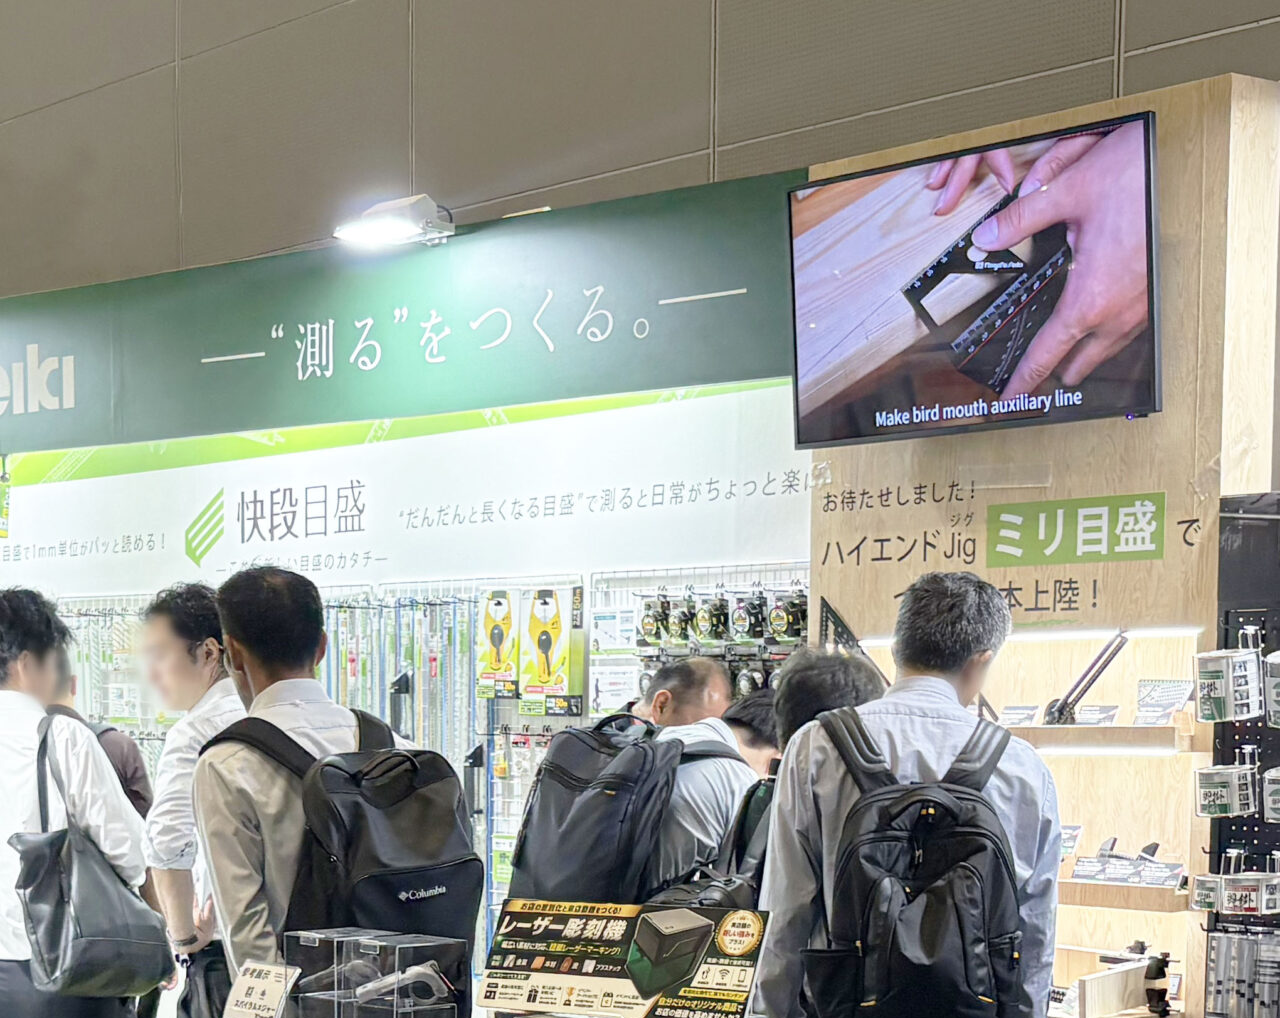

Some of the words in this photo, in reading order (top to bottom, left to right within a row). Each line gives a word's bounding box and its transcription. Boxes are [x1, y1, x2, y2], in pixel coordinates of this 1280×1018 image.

[875, 410, 910, 428] Make
[913, 406, 940, 424] bird
[942, 401, 988, 419] mouth
[991, 394, 1051, 415] auxiliary
[1054, 389, 1082, 408] line
[237, 480, 366, 544] 快段目盛
[822, 481, 975, 512] お待たせしました！
[950, 512, 974, 528] ジグ
[995, 501, 1157, 557] ミリ目盛
[1177, 517, 1201, 548] で
[409, 885, 446, 899] Columbia
[498, 915, 628, 941] レーザー彫刻機
